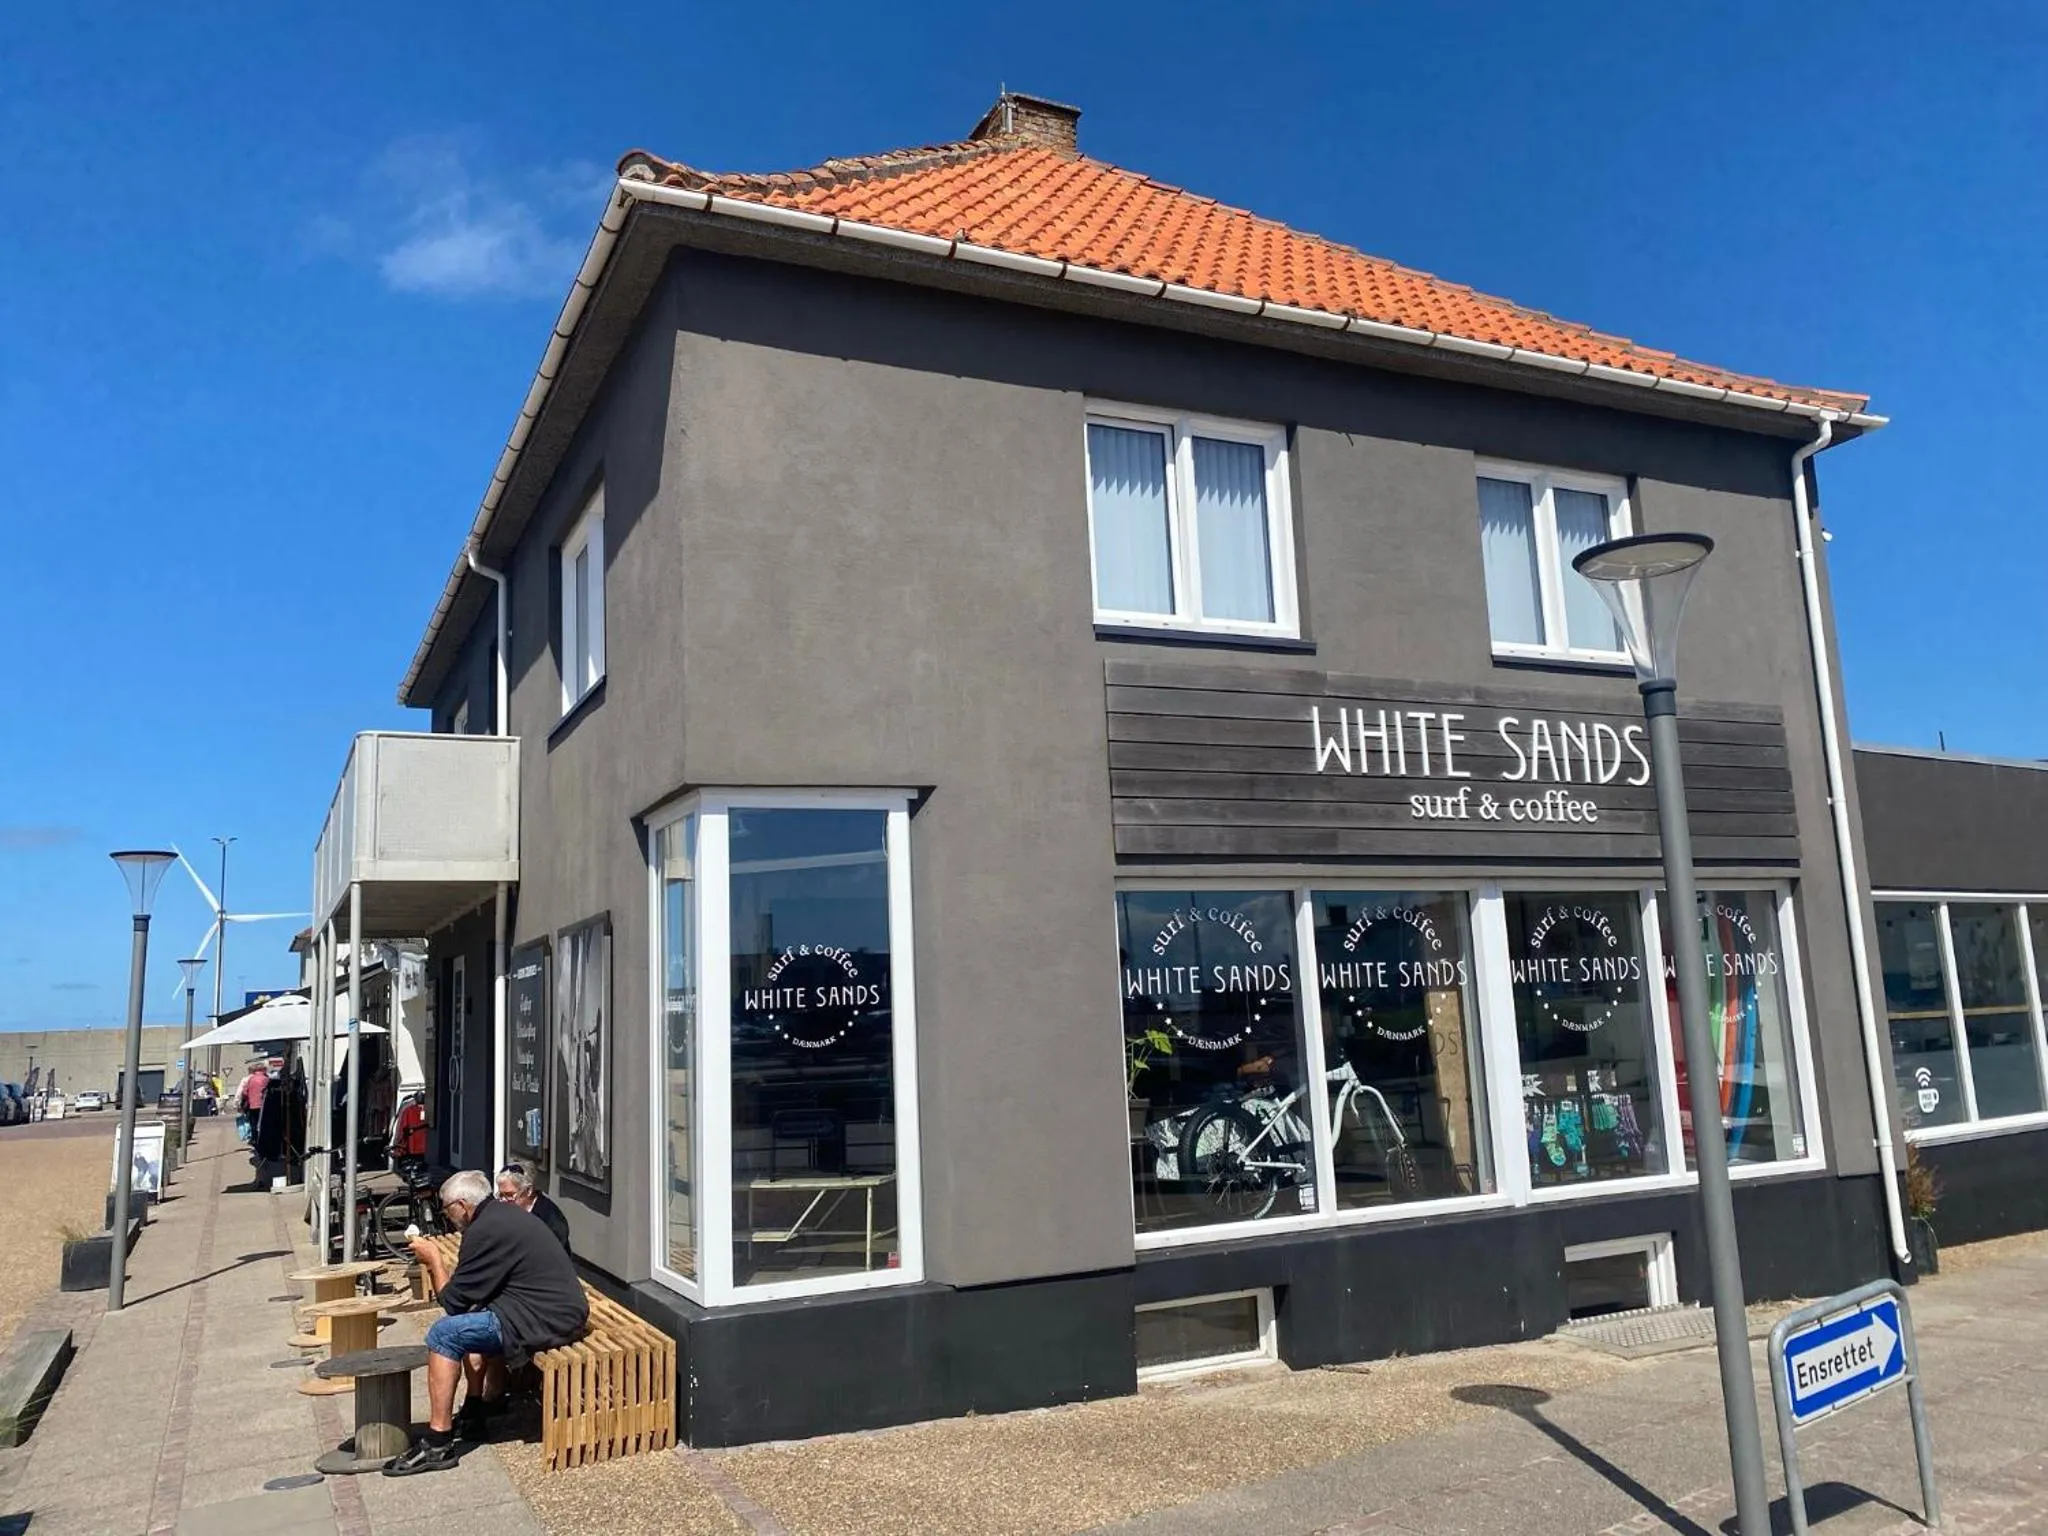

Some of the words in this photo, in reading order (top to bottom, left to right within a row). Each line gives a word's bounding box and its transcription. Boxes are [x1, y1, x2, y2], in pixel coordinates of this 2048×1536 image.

[1312, 706, 1471, 777] WHITE
[1499, 717, 1650, 786] SANDS
[1411, 787, 1471, 820] surf
[1479, 793, 1500, 821] &
[1510, 790, 1598, 823] coffee
[1151, 908, 1185, 956] surf
[1189, 907, 1202, 922] &
[1208, 907, 1263, 954] coffee
[1343, 907, 1373, 952] surf
[1375, 905, 1388, 920] &
[1393, 906, 1443, 951] coffee
[1530, 906, 1557, 949] surf
[1558, 905, 1570, 919] &
[1573, 906, 1618, 947] coffee
[1716, 904, 1757, 944] coffee
[767, 945, 796, 981] surf
[799, 944, 811, 956] &
[814, 944, 858, 978] coffee
[1126, 966, 1202, 996] WHITE
[1213, 964, 1291, 993] SANDS
[1321, 962, 1389, 989] WHITE
[1399, 960, 1468, 987] SANDS
[1511, 958, 1571, 984] WHITE
[1579, 956, 1641, 982] SANDS
[1722, 952, 1779, 977] SANDS
[744, 987, 807, 1010] WHITE
[815, 984, 880, 1007] SANDS
[1796, 1336, 1875, 1389] Ensrettet
